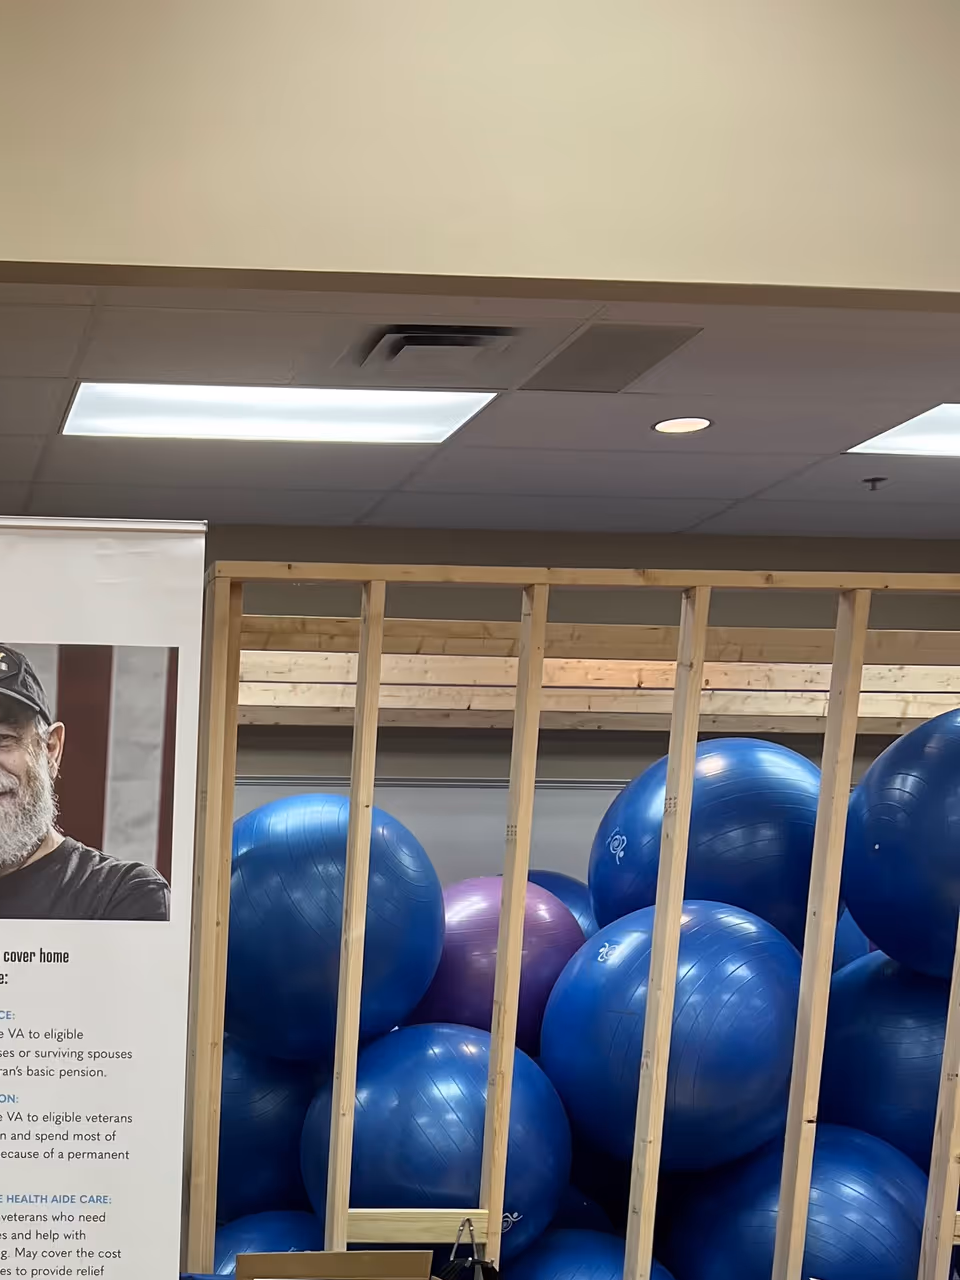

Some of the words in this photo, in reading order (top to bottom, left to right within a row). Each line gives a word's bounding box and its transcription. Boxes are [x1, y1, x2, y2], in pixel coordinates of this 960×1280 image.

[3, 950, 36, 962] cover
[40, 947, 69, 963] home
[18, 1049, 31, 1058] or
[35, 1046, 84, 1062] surviving
[87, 1050, 132, 1061] spouses
[7, 1194, 48, 1203] HEALTH
[51, 1194, 76, 1203] AIDE
[80, 1194, 111, 1204] CARE:
[11, 1228, 31, 1240] and
[35, 1228, 59, 1243] help
[63, 1228, 86, 1240] with
[15, 1246, 38, 1260] May
[41, 1249, 73, 1258] cover
[76, 1246, 94, 1258] the
[98, 1249, 121, 1258] cost
